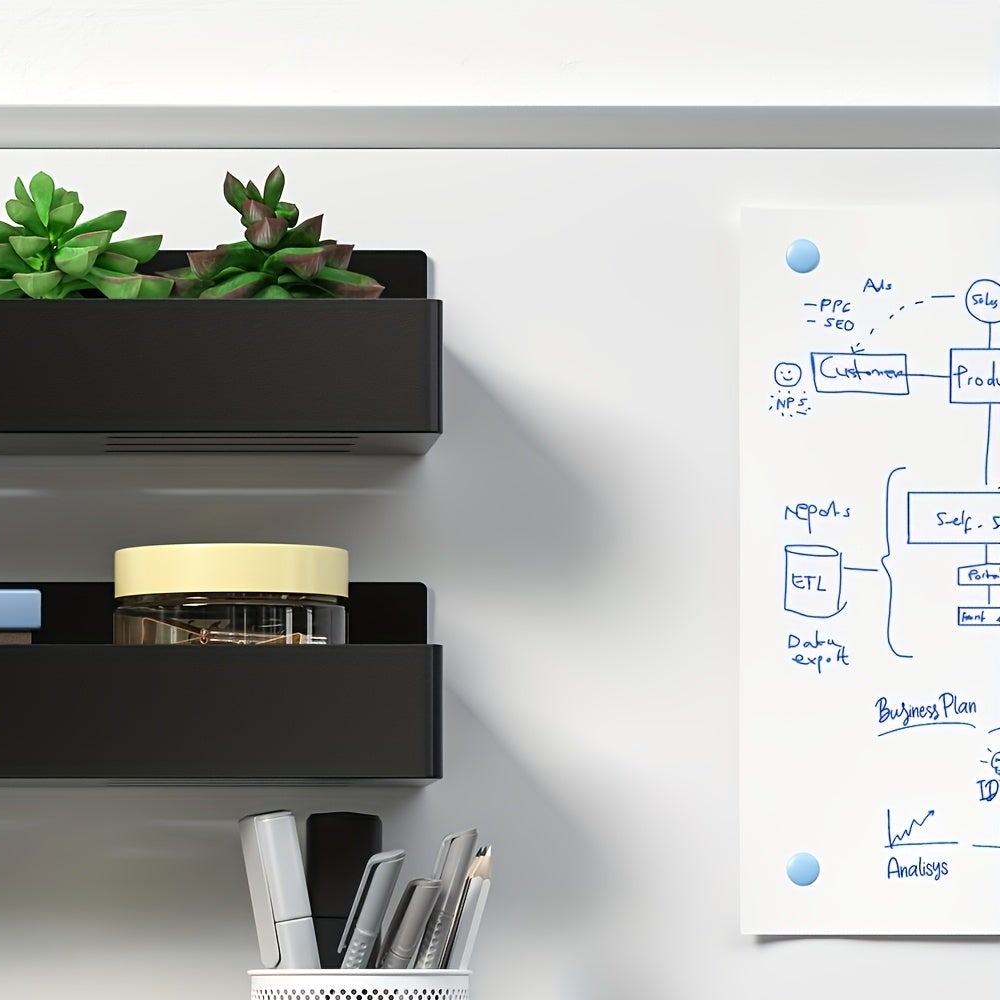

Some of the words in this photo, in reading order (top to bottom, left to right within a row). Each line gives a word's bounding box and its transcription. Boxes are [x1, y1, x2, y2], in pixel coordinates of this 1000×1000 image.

[862, 278, 892, 292] Ads
[776, 396, 808, 410] NPS
[791, 572, 827, 592] ETL
[874, 696, 940, 726] Business
[938, 692, 977, 718] Plan
[976, 778, 1000, 802] ID
[887, 856, 949, 881] Analisys
